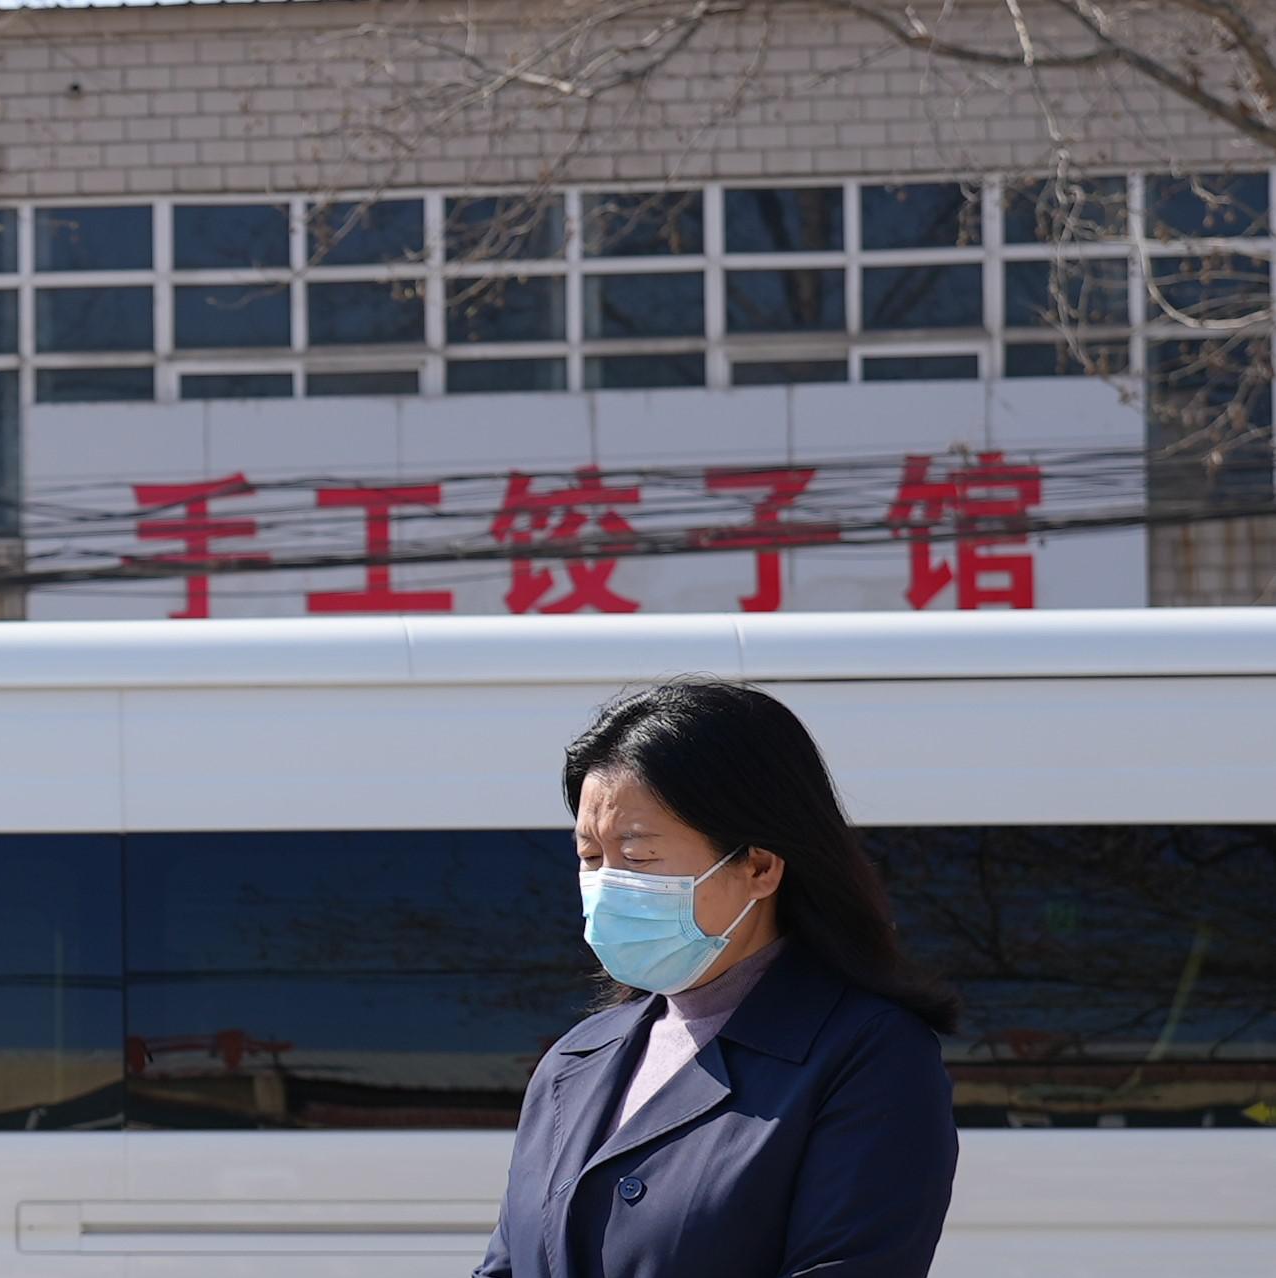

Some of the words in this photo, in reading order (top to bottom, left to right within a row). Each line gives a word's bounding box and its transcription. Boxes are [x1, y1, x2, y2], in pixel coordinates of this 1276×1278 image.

[121, 450, 1042, 619] 手工饺子馆
